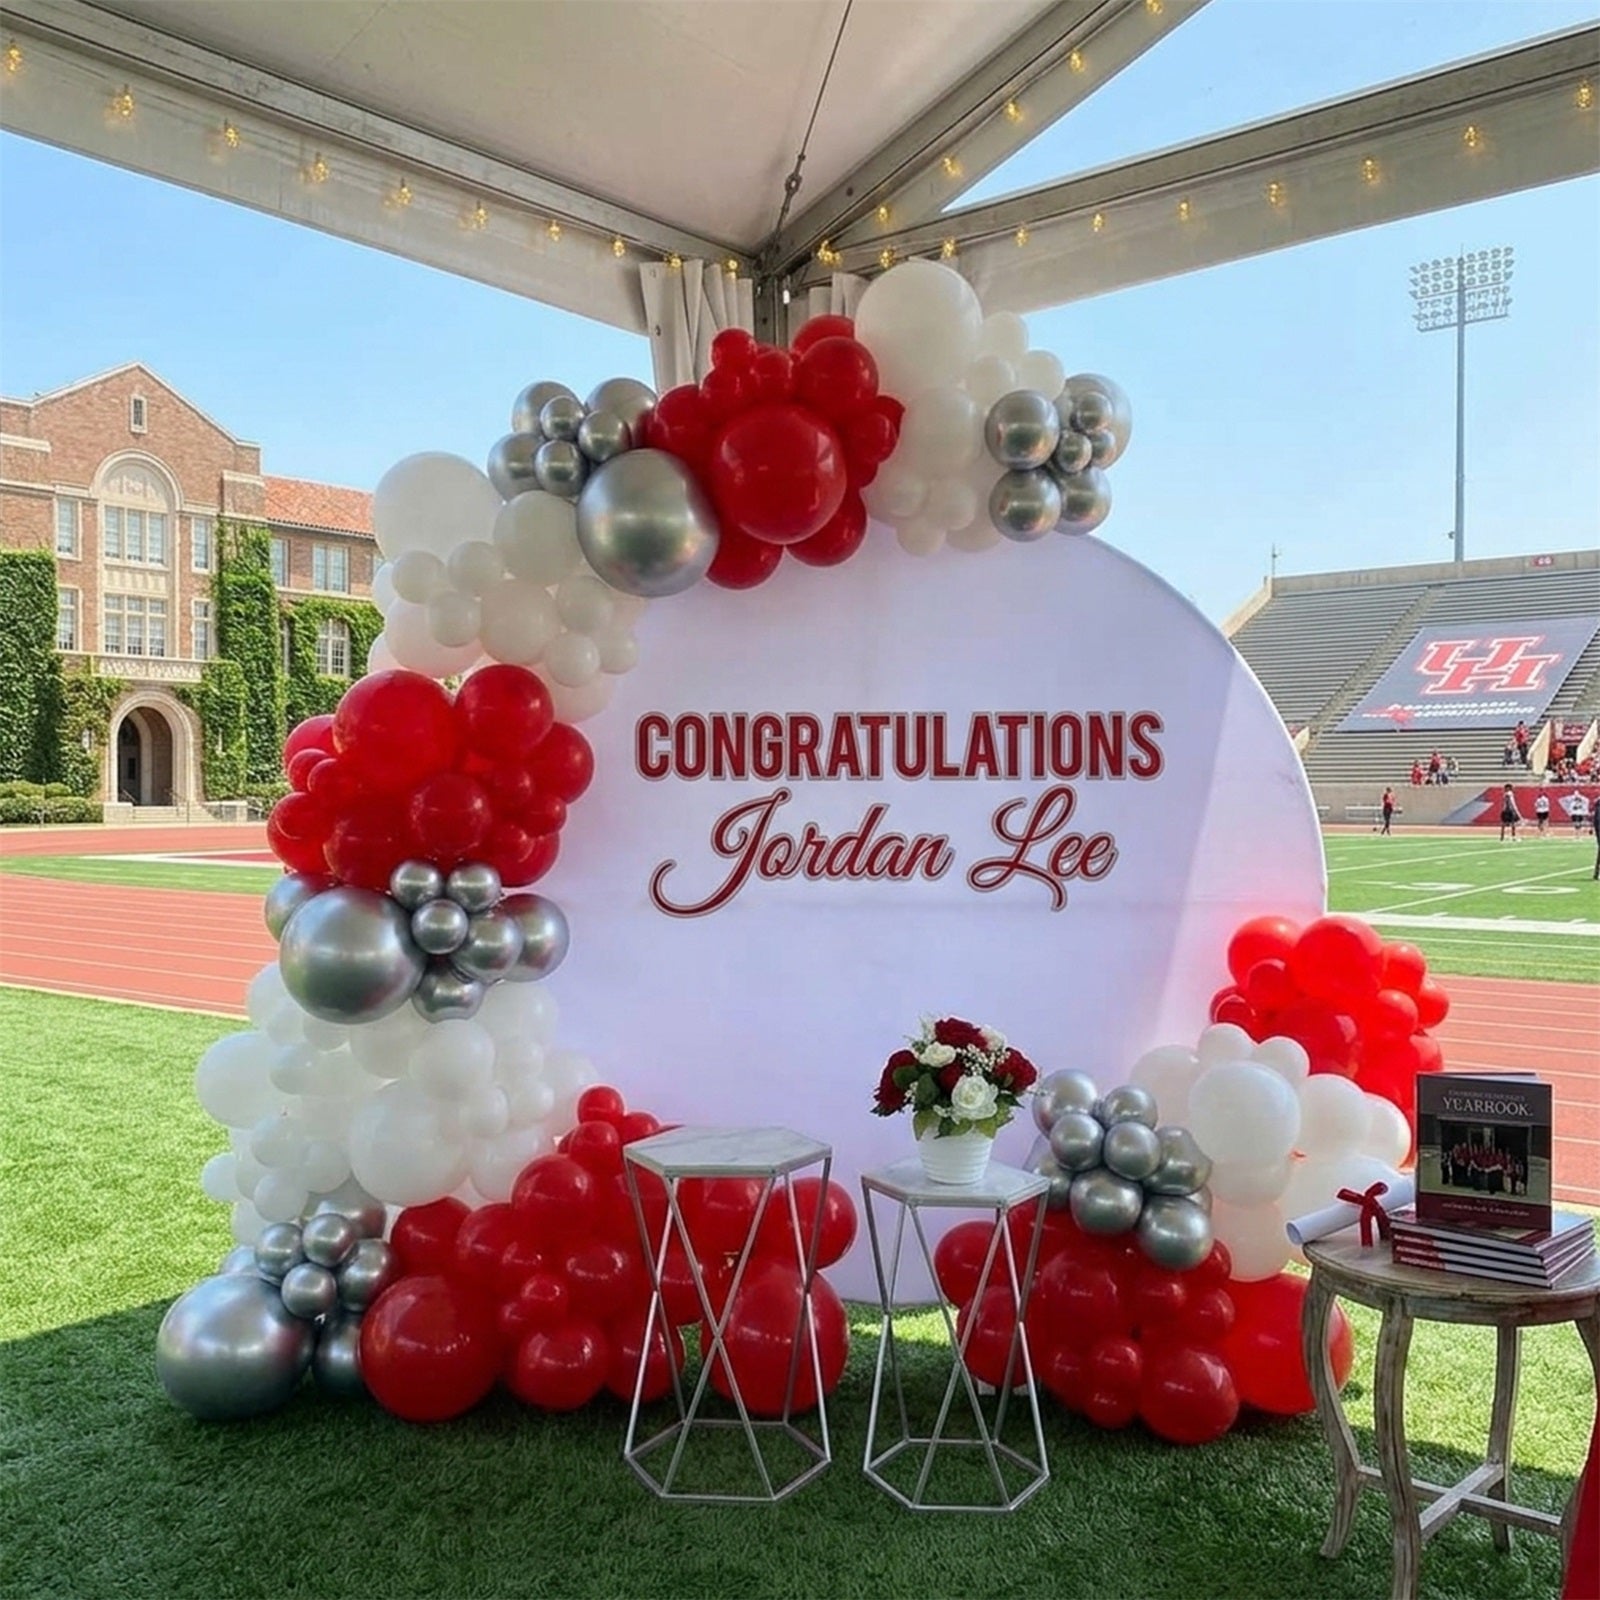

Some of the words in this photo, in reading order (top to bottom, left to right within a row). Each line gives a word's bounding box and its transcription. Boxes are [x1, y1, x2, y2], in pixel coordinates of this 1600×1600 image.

[634, 711, 1165, 780] CONGRATULATIONS
[648, 787, 955, 918] Jordan
[967, 783, 1119, 911] Lee
